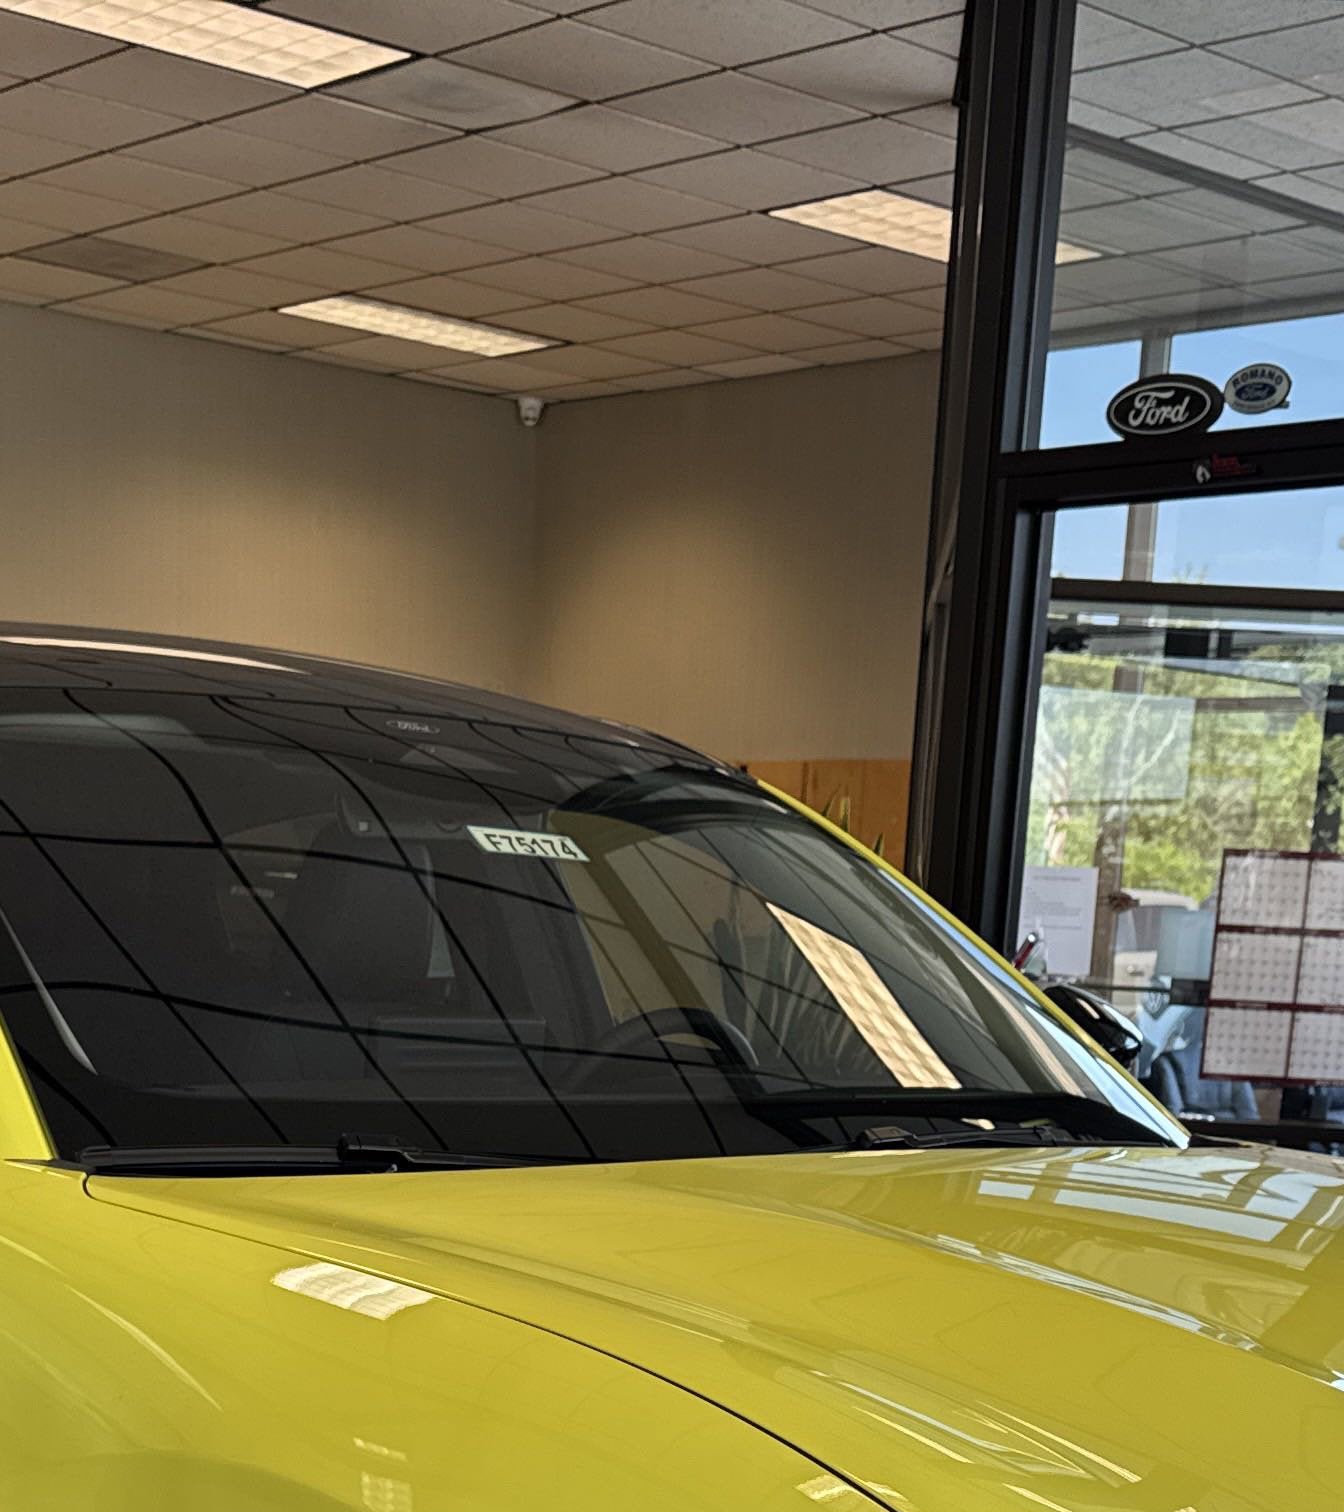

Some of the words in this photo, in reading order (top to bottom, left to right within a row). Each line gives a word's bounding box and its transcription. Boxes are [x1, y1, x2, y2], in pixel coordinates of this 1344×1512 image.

[1232, 368, 1284, 388] ROMANO
[1128, 389, 1190, 427] Ford
[485, 833, 579, 859] F75174
